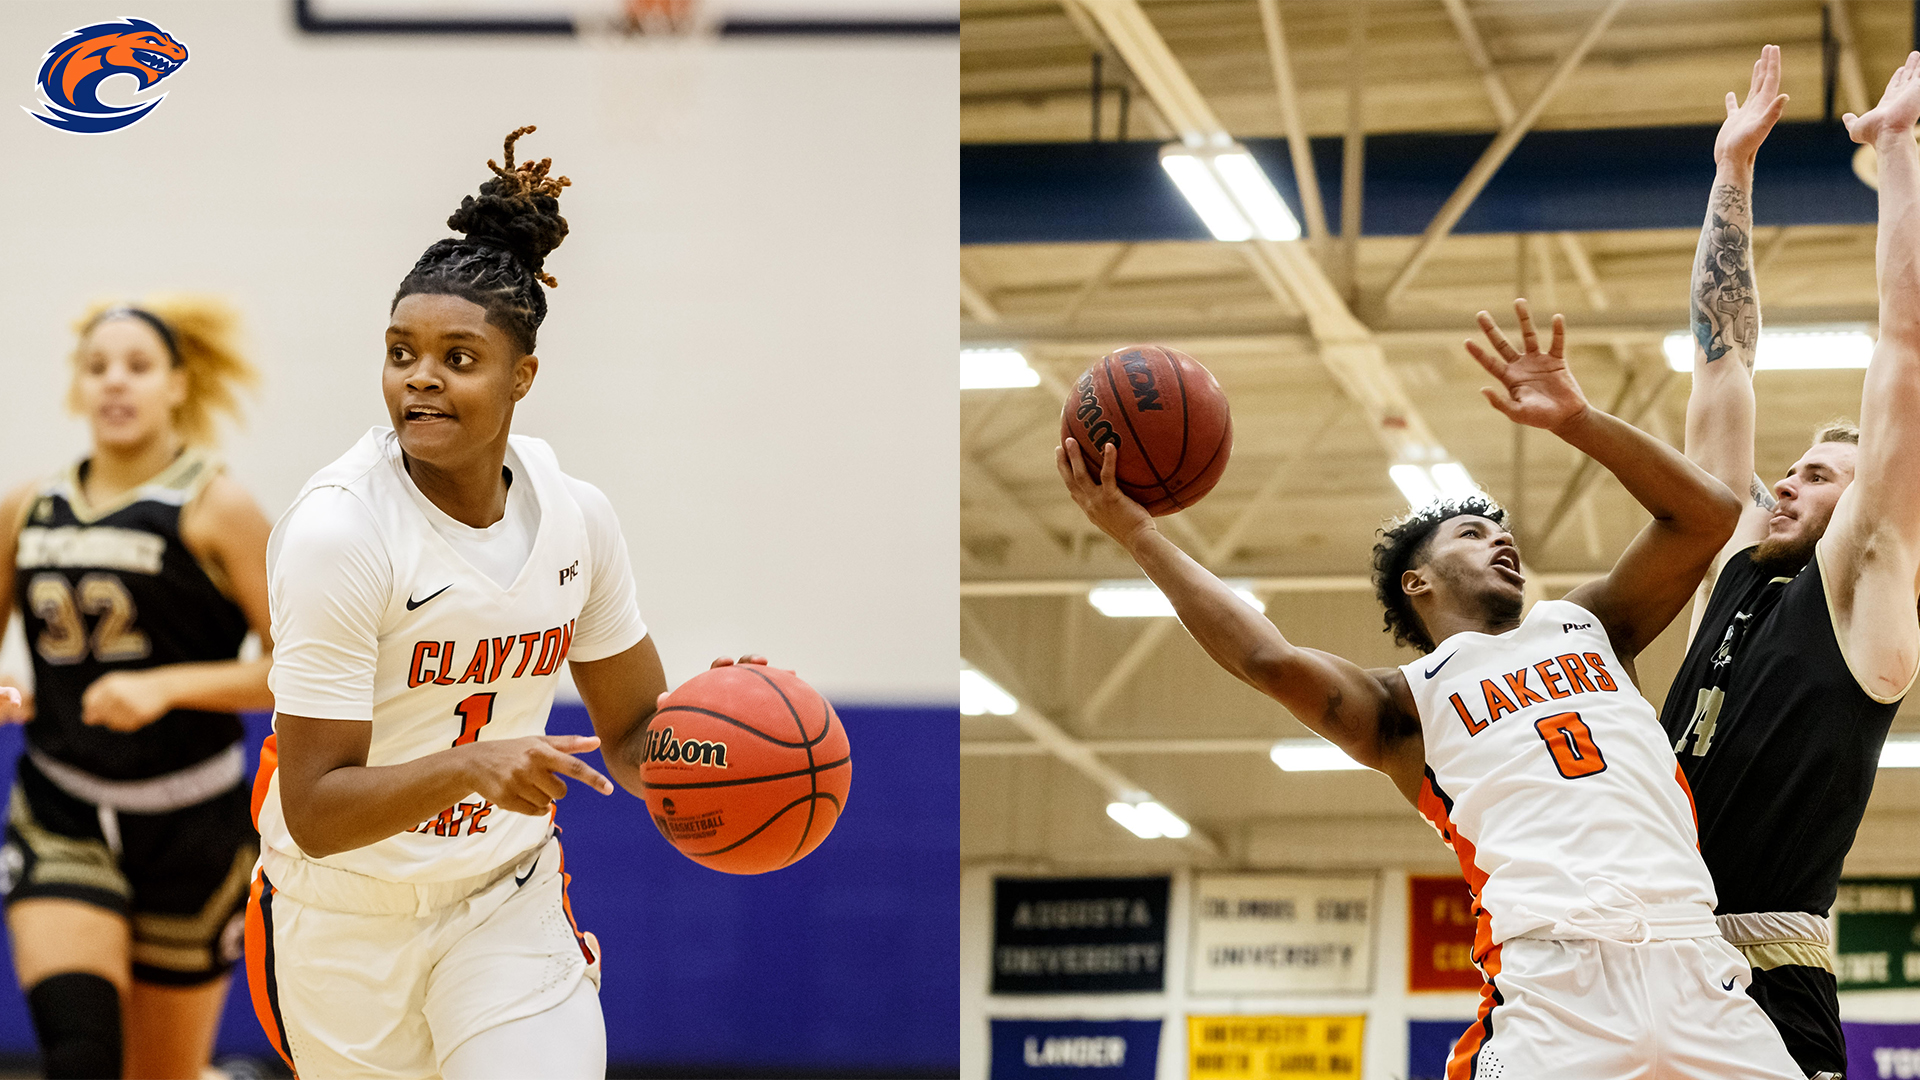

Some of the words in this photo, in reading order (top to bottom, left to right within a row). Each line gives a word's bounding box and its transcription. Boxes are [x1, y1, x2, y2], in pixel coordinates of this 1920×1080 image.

[1120, 351, 1164, 413] NCAA
[27, 572, 152, 664] 32
[407, 618, 575, 688] CLAYTON
[452, 691, 498, 748] 1
[1448, 651, 1619, 738] LAKERS
[1533, 711, 1608, 780] 0
[405, 800, 492, 837] ATE
[668, 815, 725, 833] BASKETBALL
[999, 944, 1161, 974] UNIVERSITY
[1207, 944, 1354, 968] UNIVERSITY
[1024, 1036, 1127, 1067] LANDER
